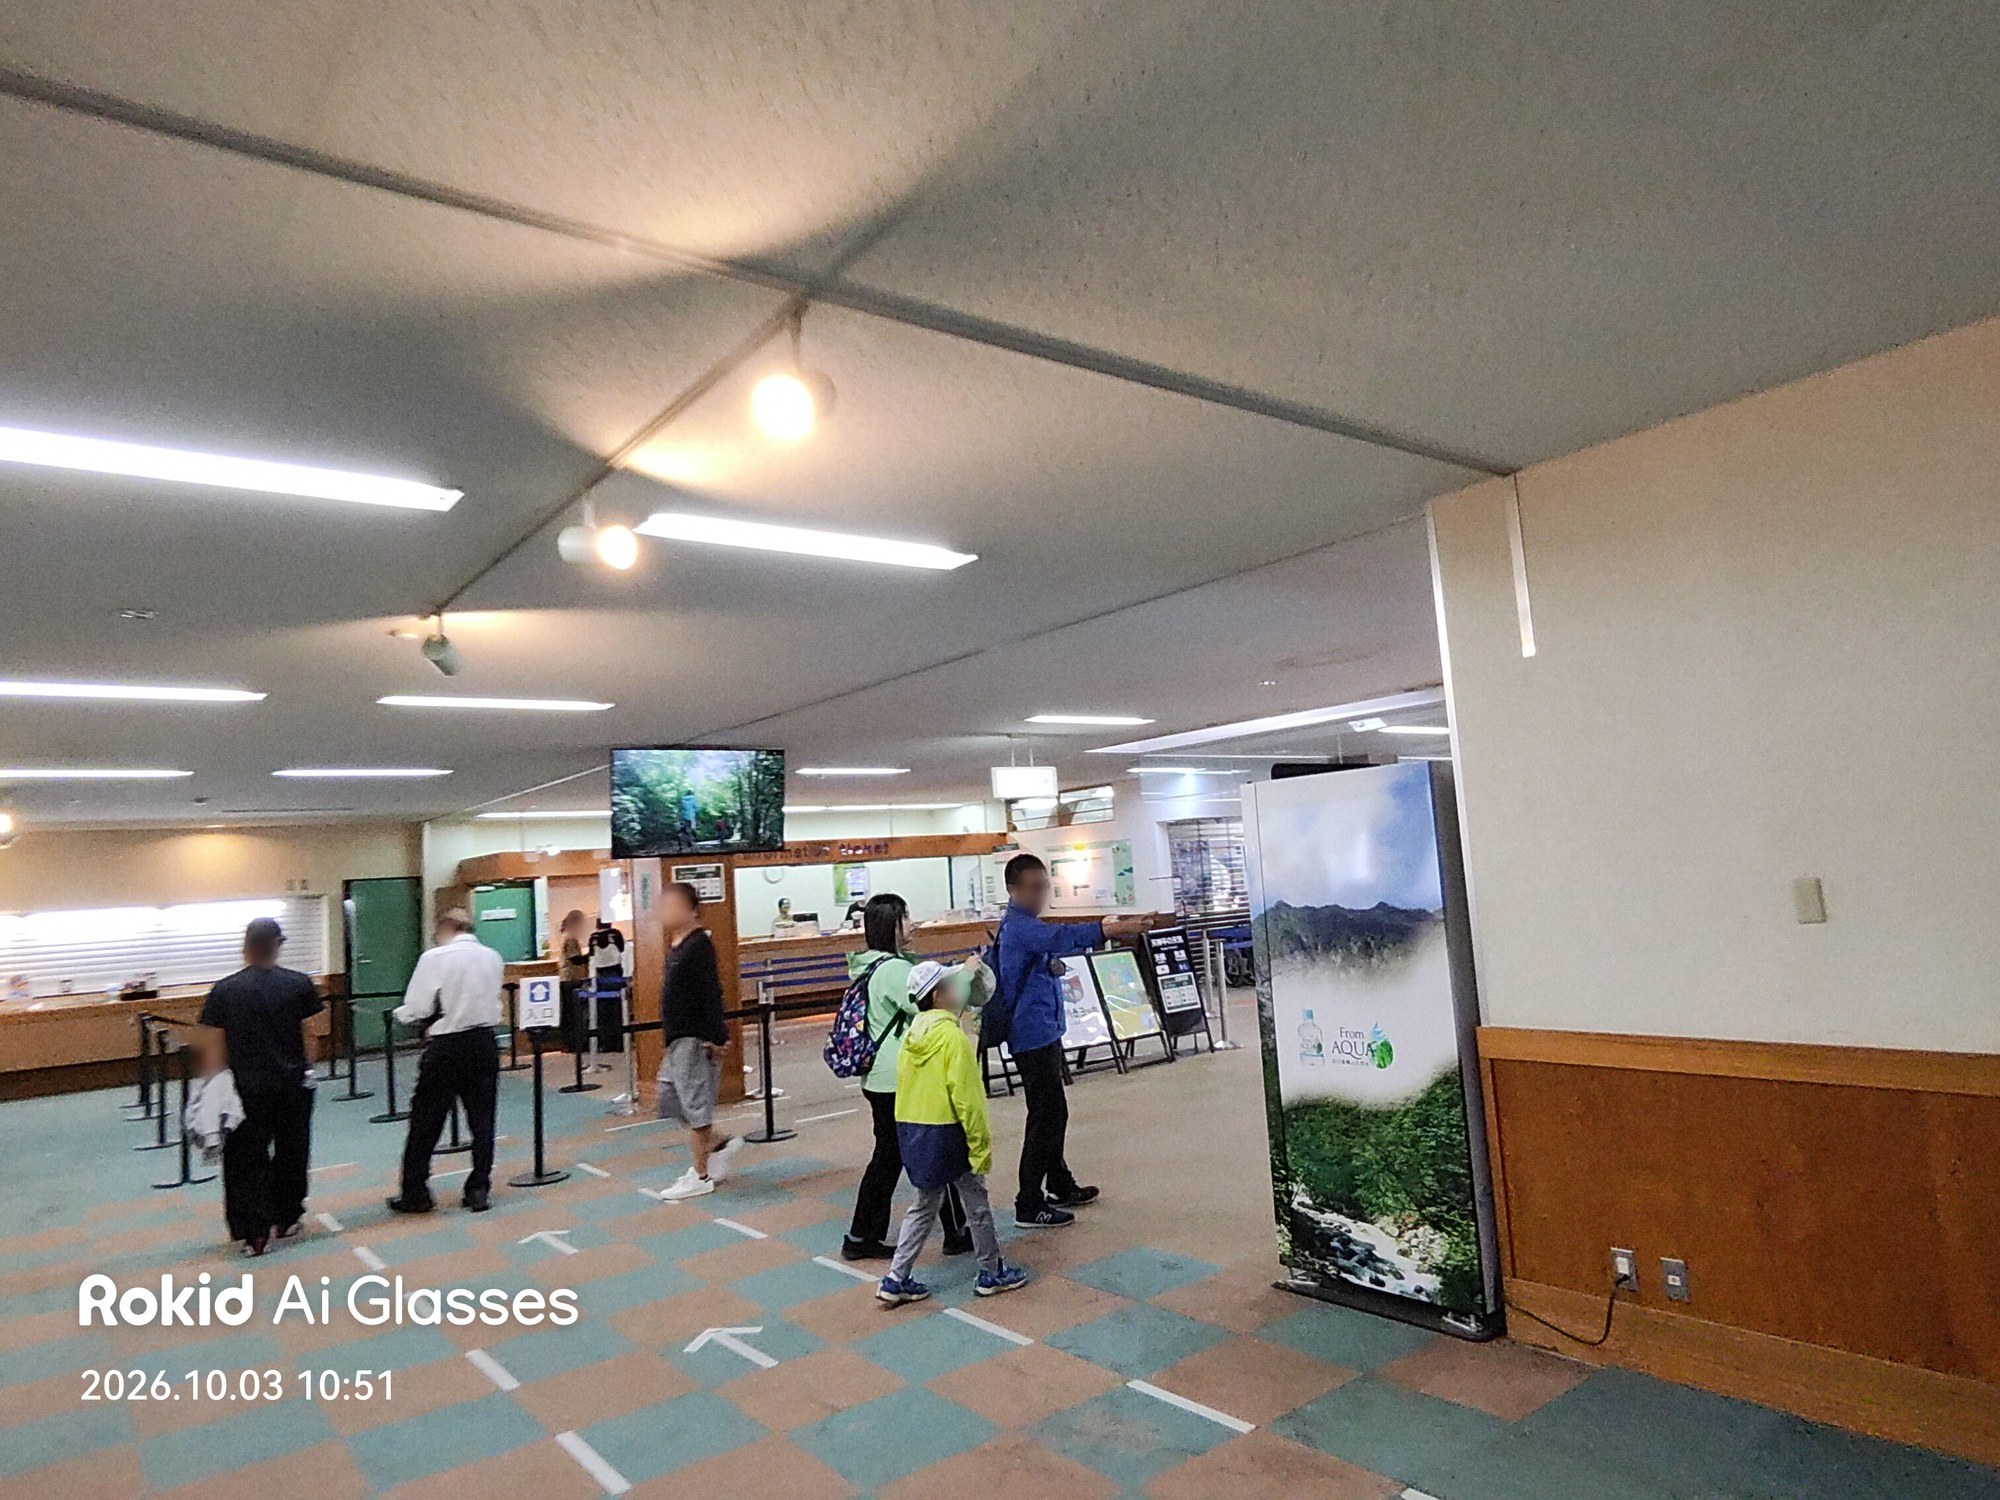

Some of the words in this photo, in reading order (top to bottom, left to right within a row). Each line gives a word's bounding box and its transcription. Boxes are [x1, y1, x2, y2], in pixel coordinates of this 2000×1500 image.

[526, 1008, 553, 1019] 入口
[1339, 1026, 1365, 1040] From
[1331, 1039, 1375, 1060] AQUA
